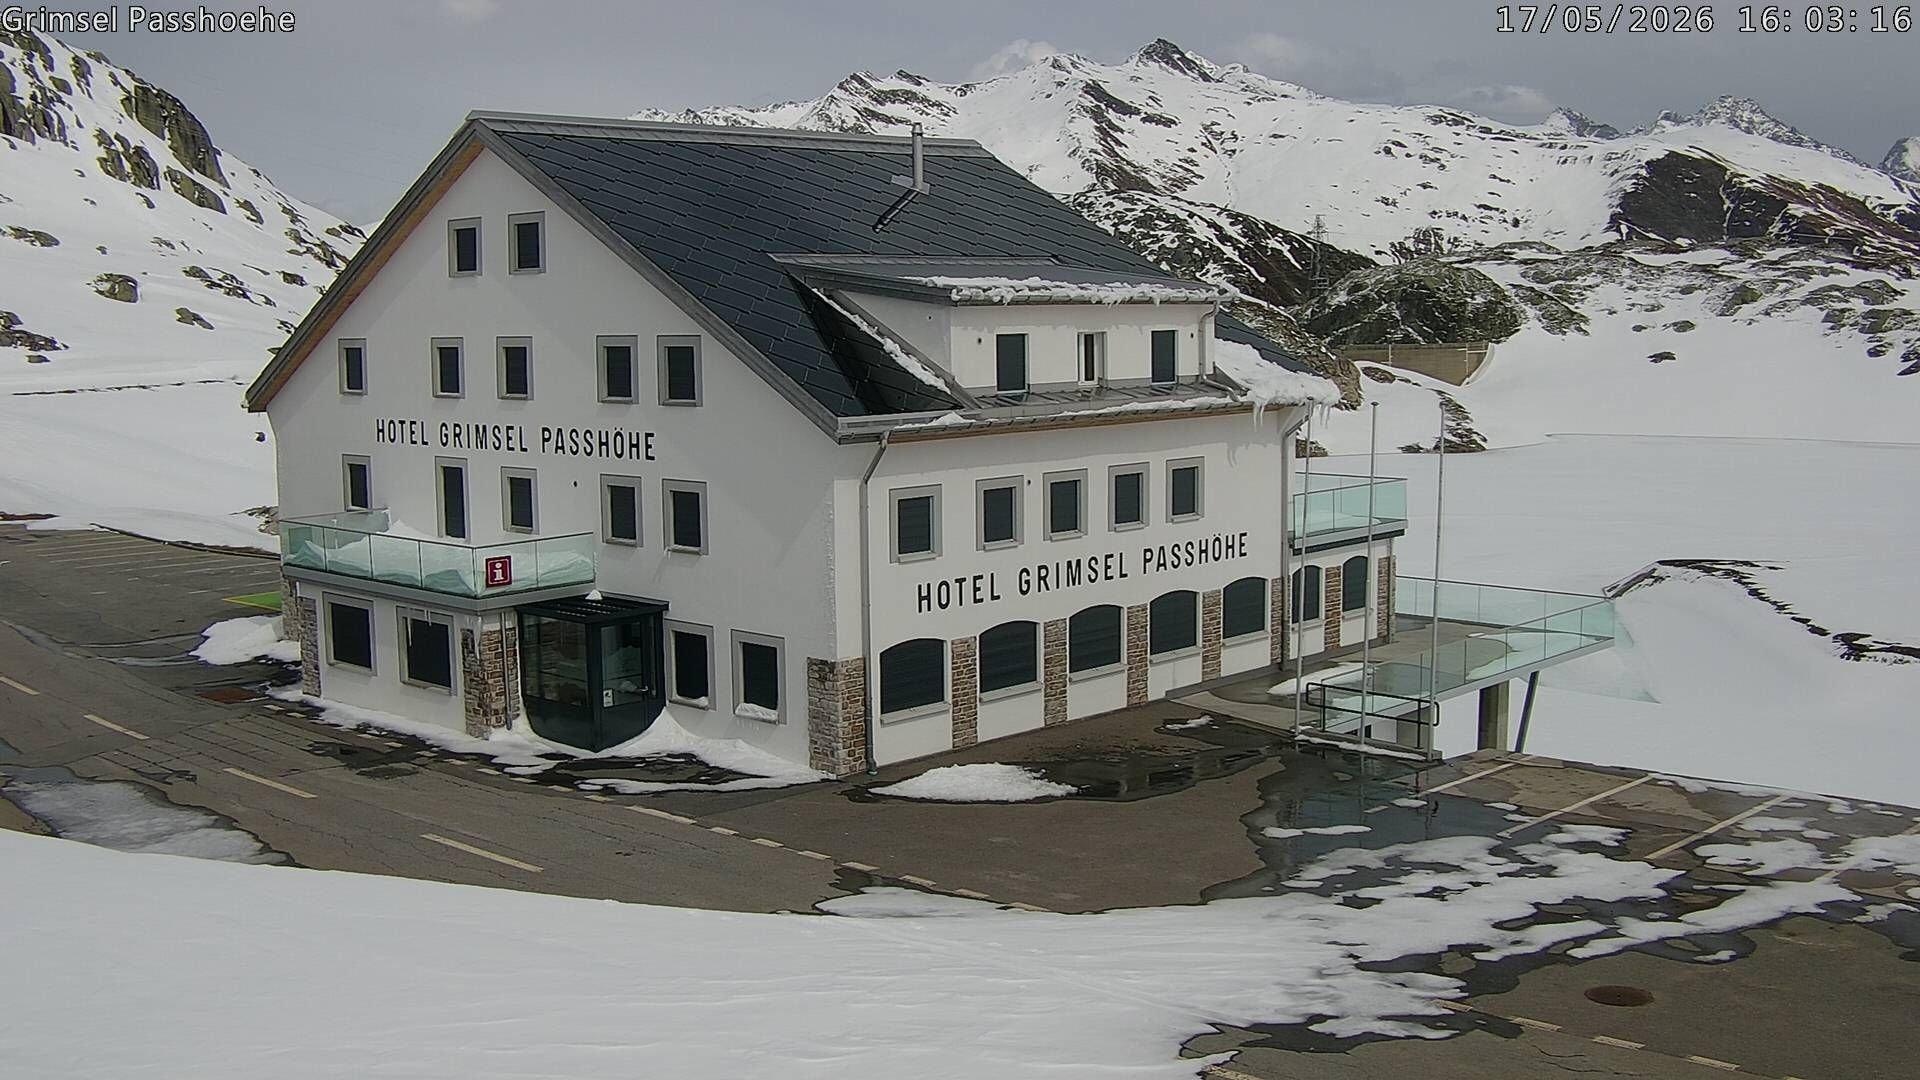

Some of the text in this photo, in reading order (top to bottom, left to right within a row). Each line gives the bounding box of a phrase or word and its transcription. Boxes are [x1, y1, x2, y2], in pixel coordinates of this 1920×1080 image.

[376, 418, 656, 461] HOTEL GRIMSEL PASSHÖHE
[917, 531, 1249, 614] HOTEL GRIMSEL PASSHÖHE
